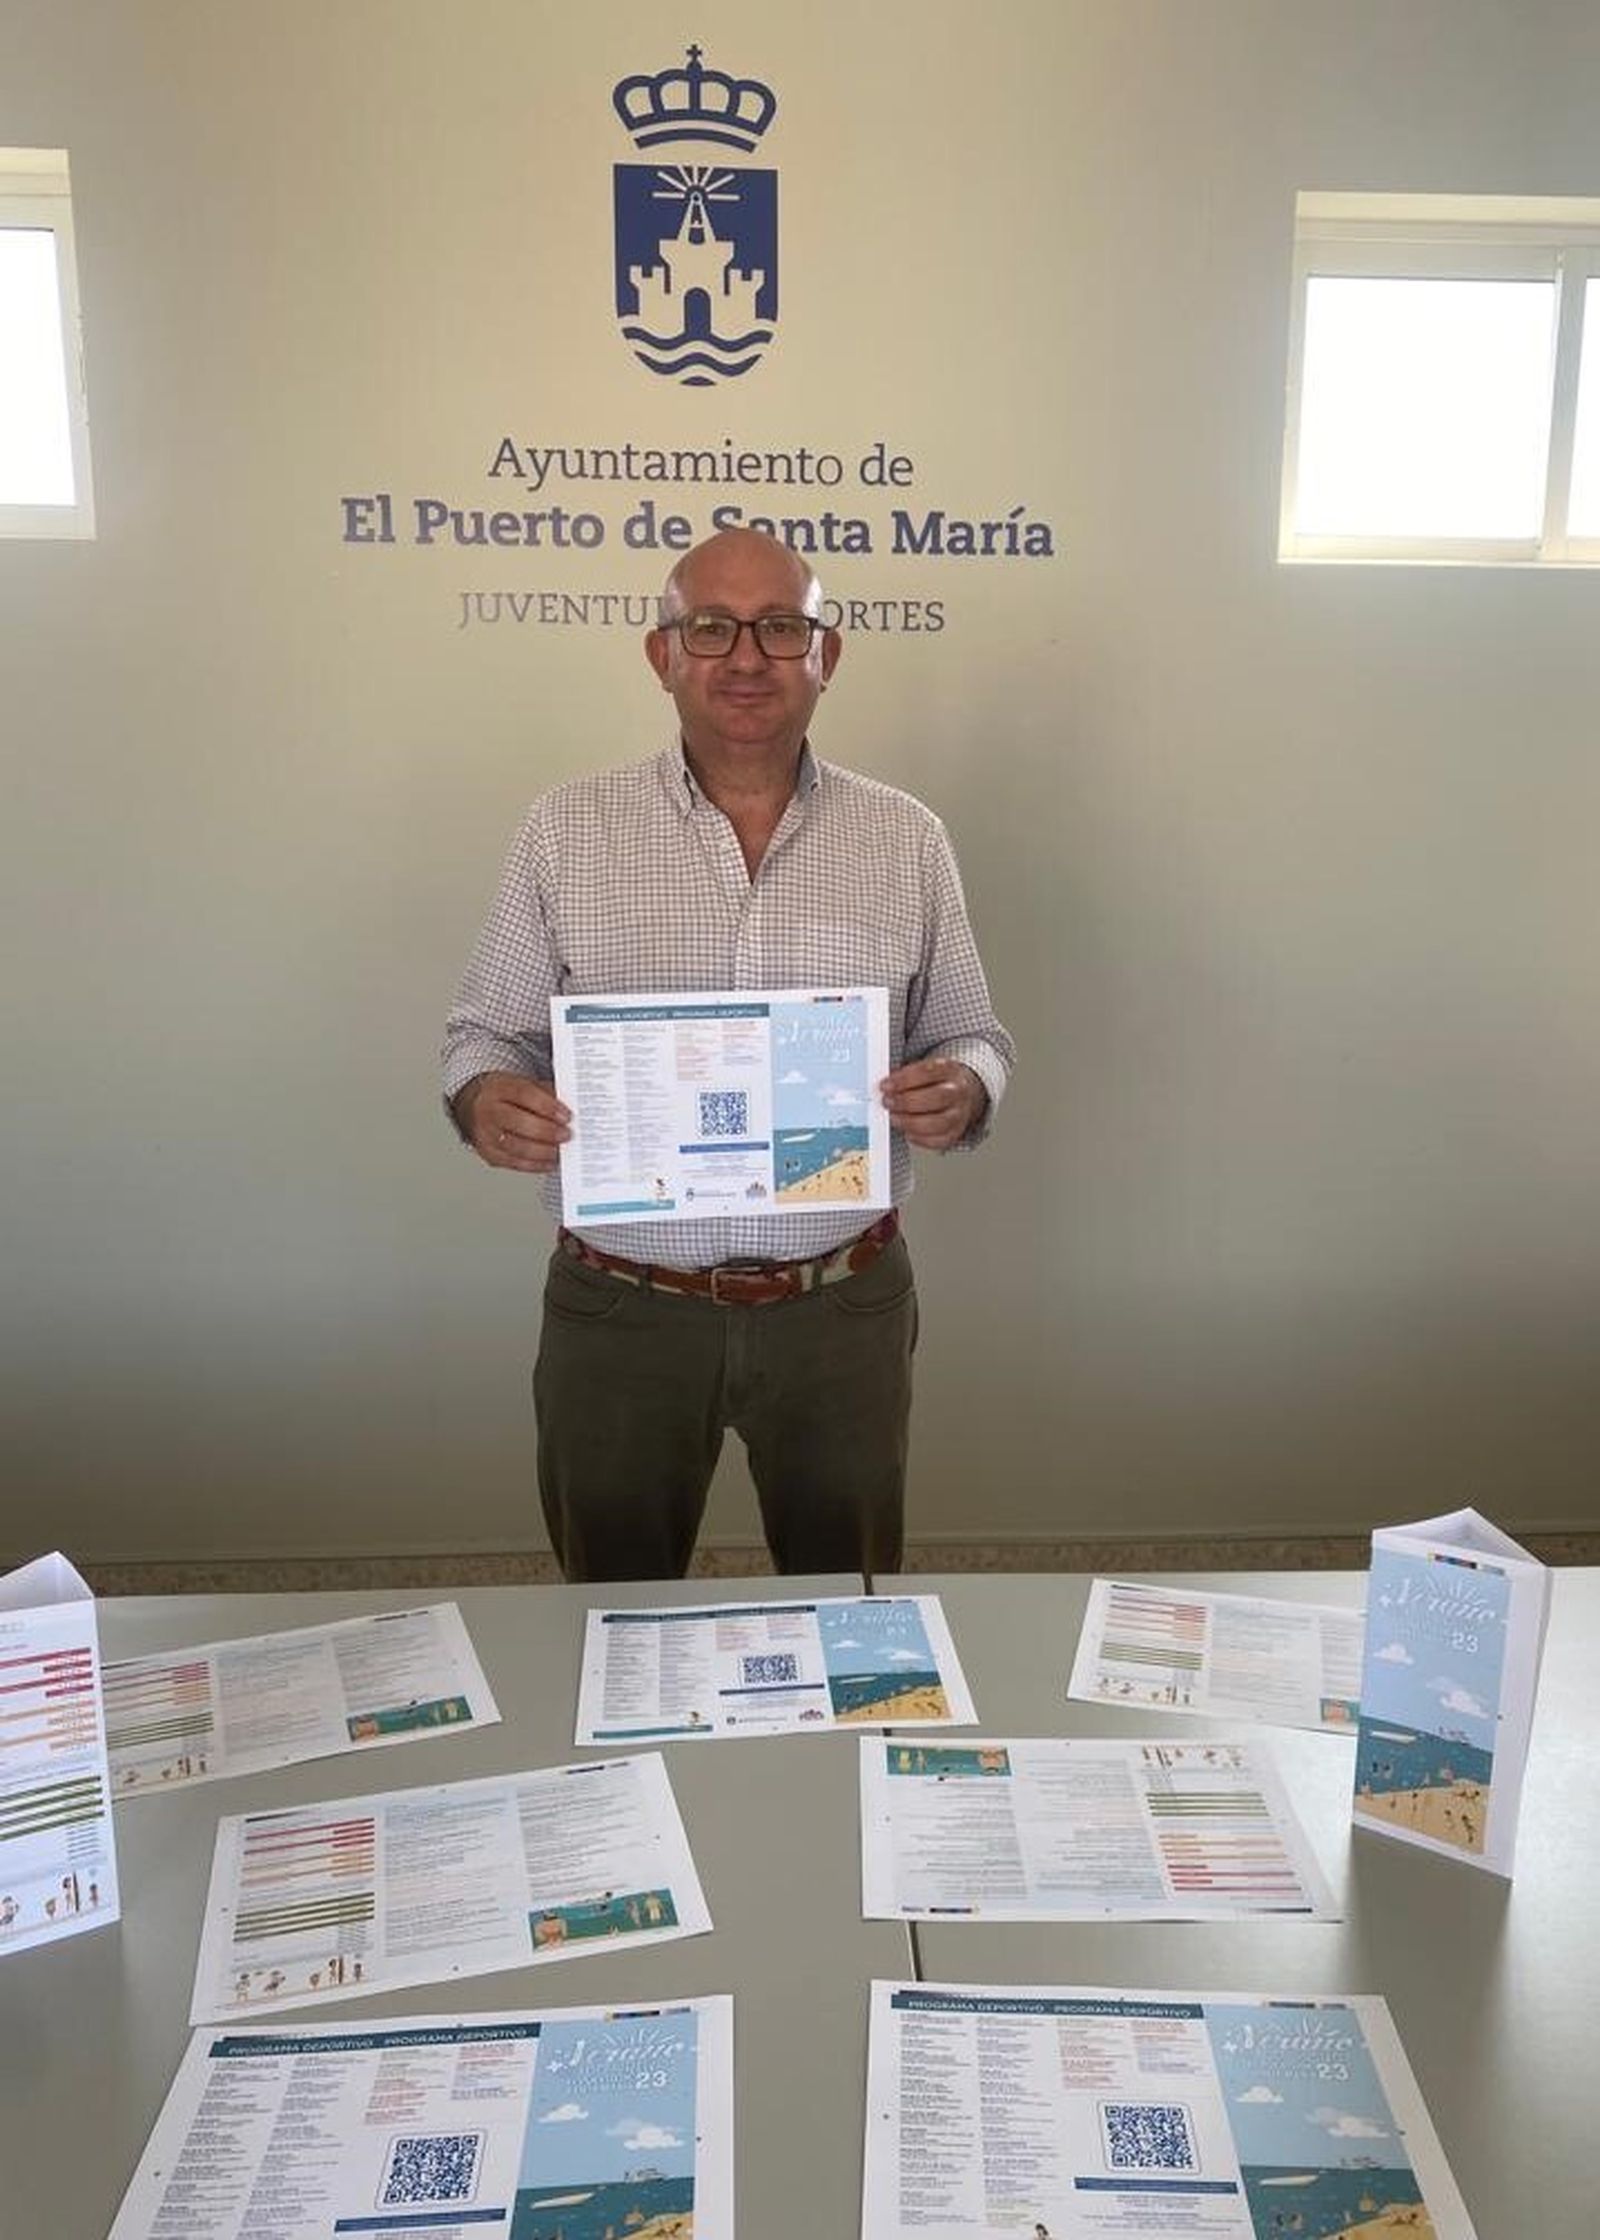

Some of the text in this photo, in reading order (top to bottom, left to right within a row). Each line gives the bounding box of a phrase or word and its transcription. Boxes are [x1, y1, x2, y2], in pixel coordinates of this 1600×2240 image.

[488, 437, 914, 490] Ayuntamiento de
[341, 494, 395, 545] El
[414, 500, 604, 550] Puerto
[624, 501, 692, 550] de
[891, 508, 1054, 557] María
[459, 592, 946, 632] JUVENTU ORTES
[635, 2070, 668, 2090] 23
[1316, 2062, 1349, 2082] 23
